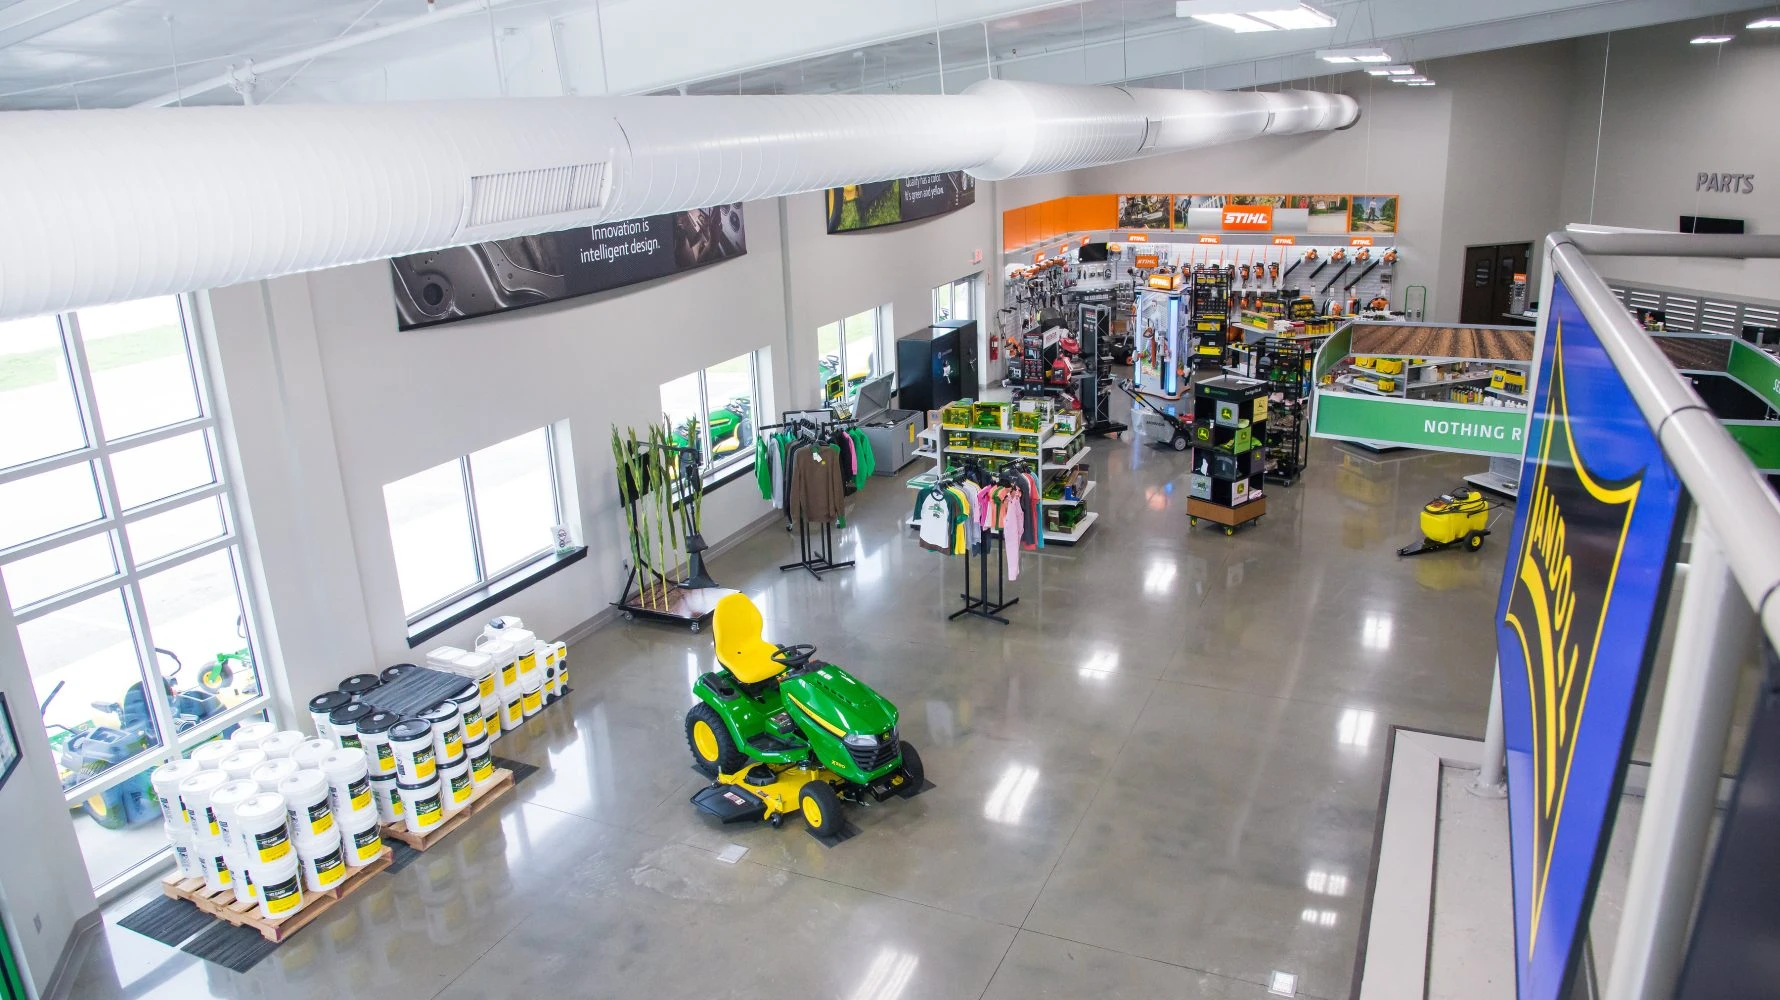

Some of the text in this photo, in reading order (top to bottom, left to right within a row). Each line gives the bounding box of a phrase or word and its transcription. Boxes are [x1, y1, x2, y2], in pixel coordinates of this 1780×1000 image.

[1696, 172, 1754, 194] PARTS
[912, 190, 923, 202] green
[923, 186, 931, 198] and
[1224, 211, 1268, 224] STIHL
[591, 218, 650, 240] Innovation is
[580, 238, 661, 263] intelligent design.
[1150, 276, 1169, 286] STIHL
[1424, 420, 1522, 440] NOTHING R
